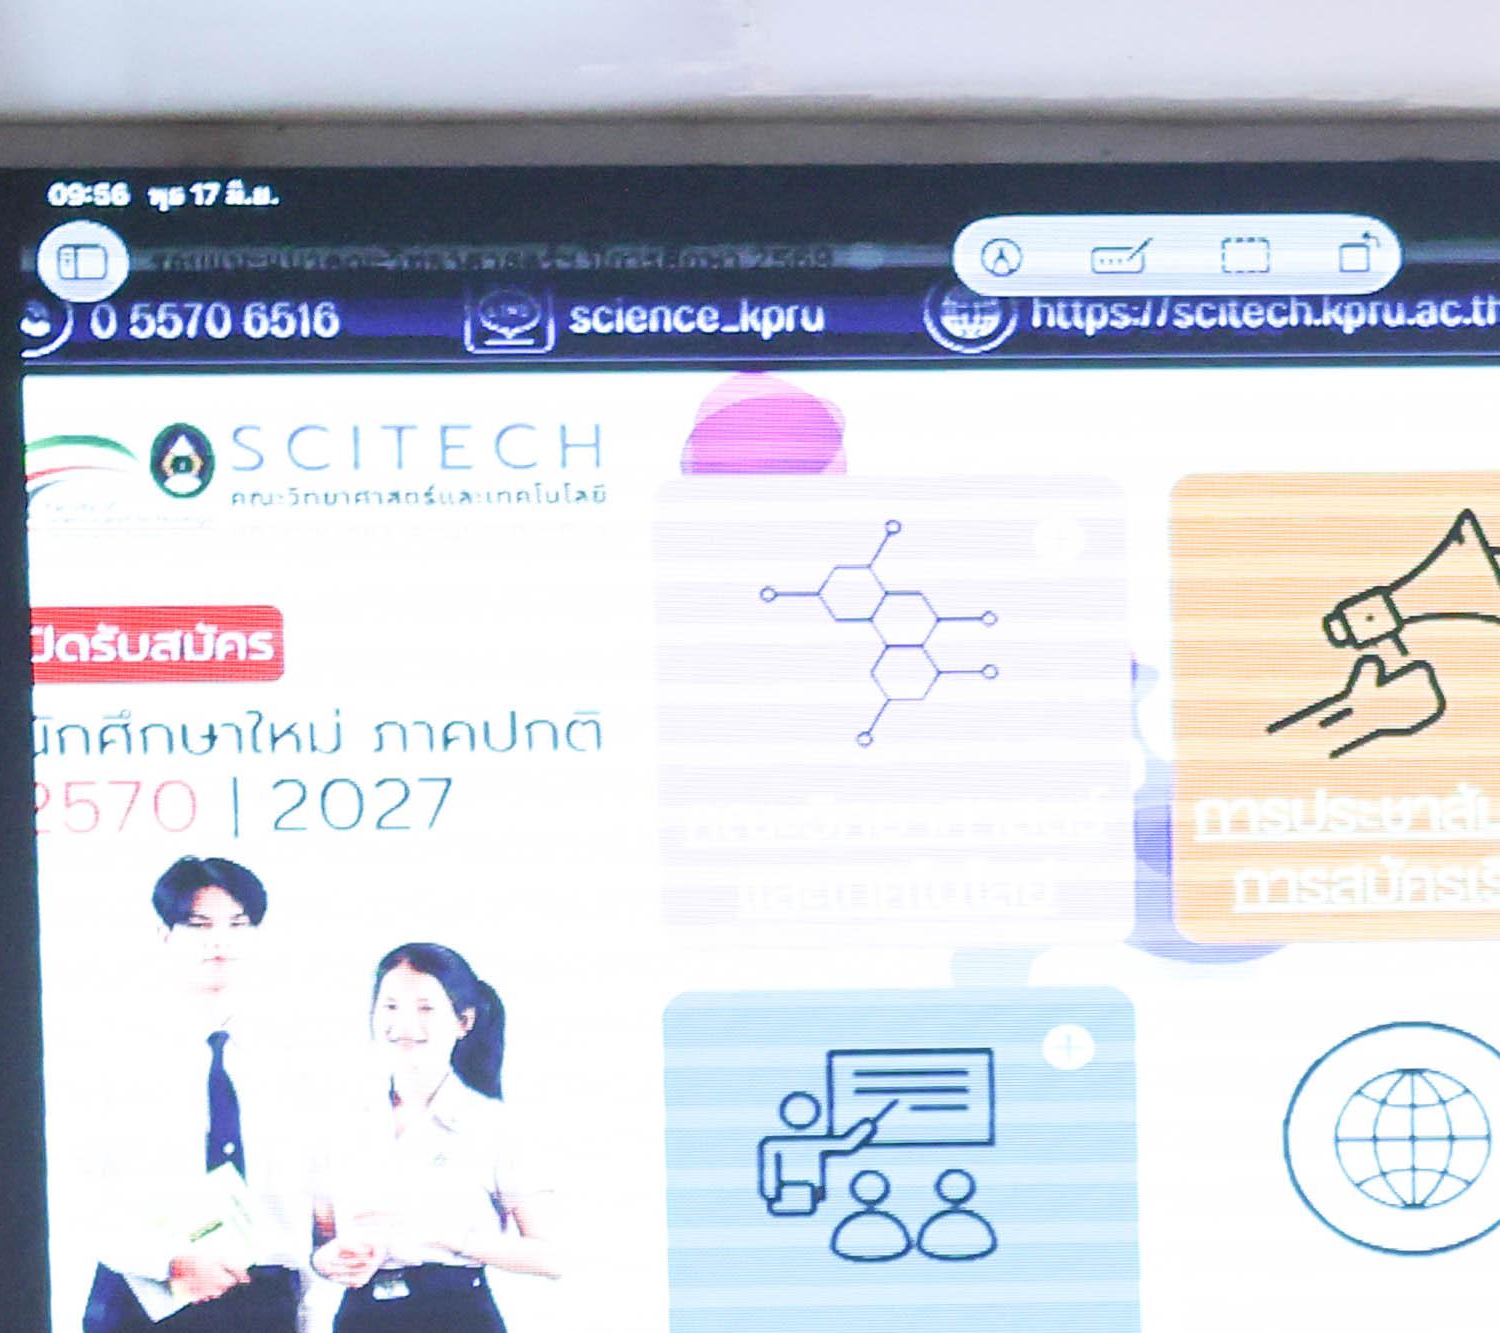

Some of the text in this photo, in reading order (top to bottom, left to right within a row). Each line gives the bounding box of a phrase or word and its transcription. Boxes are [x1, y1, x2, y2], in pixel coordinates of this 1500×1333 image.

[48, 182, 131, 207] 09:56
[191, 184, 221, 207] 17
[90, 301, 340, 340] 0 5570 6516
[569, 299, 826, 340] science_kpru
[231, 424, 602, 471] SCITECH
[374, 709, 603, 754] ภาคปกติ
[272, 777, 453, 832] 2027
